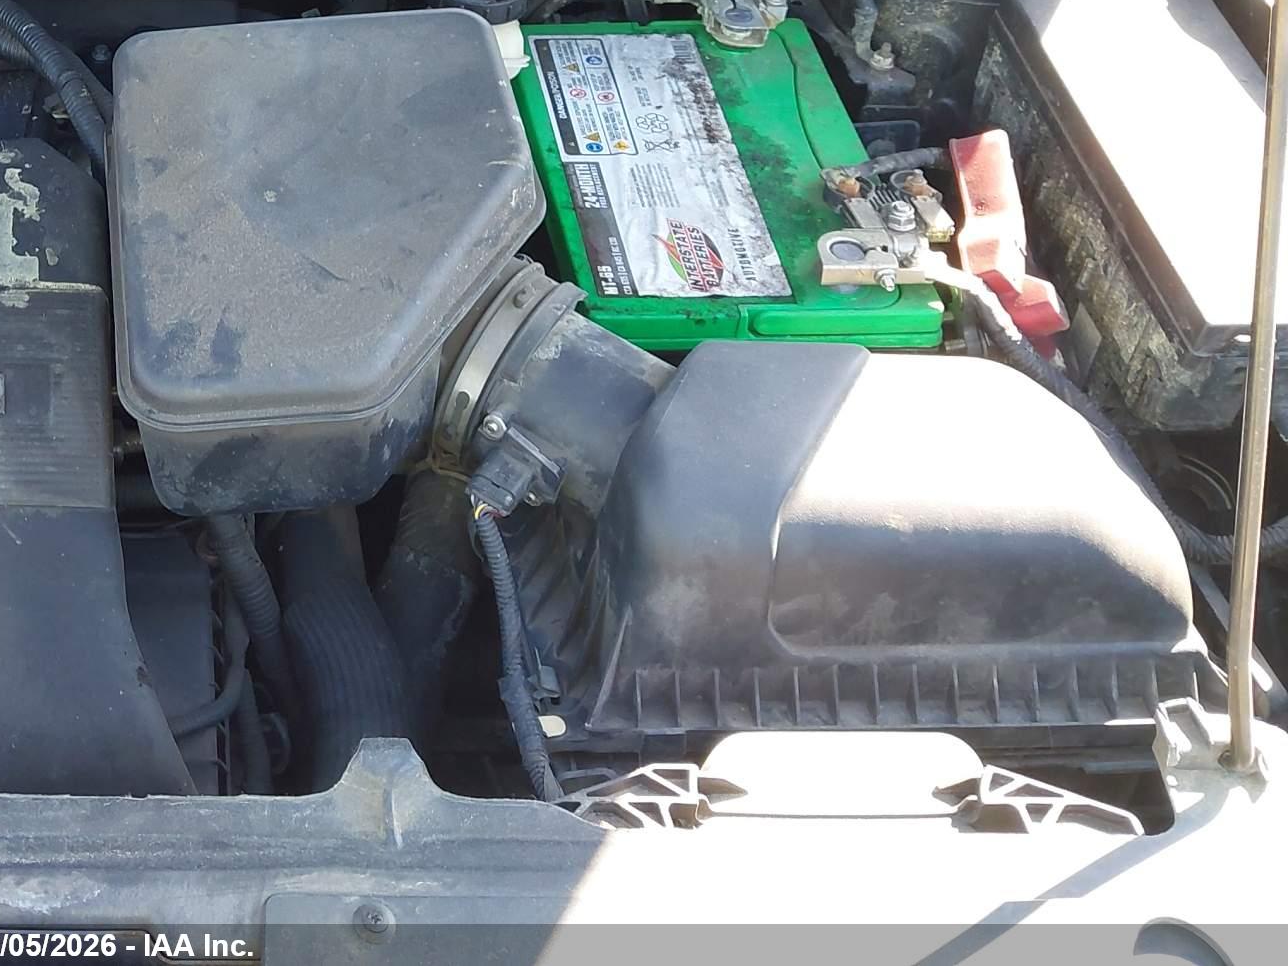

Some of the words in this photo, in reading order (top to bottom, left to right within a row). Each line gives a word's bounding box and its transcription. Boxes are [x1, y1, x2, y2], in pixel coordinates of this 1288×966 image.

[574, 163, 595, 207] 24-MONTH
[597, 265, 619, 295] MT-65
[670, 222, 699, 291] INTERSTATE
[687, 227, 718, 287] BATTERIES
[727, 228, 752, 282] AUTOMOTIVE
